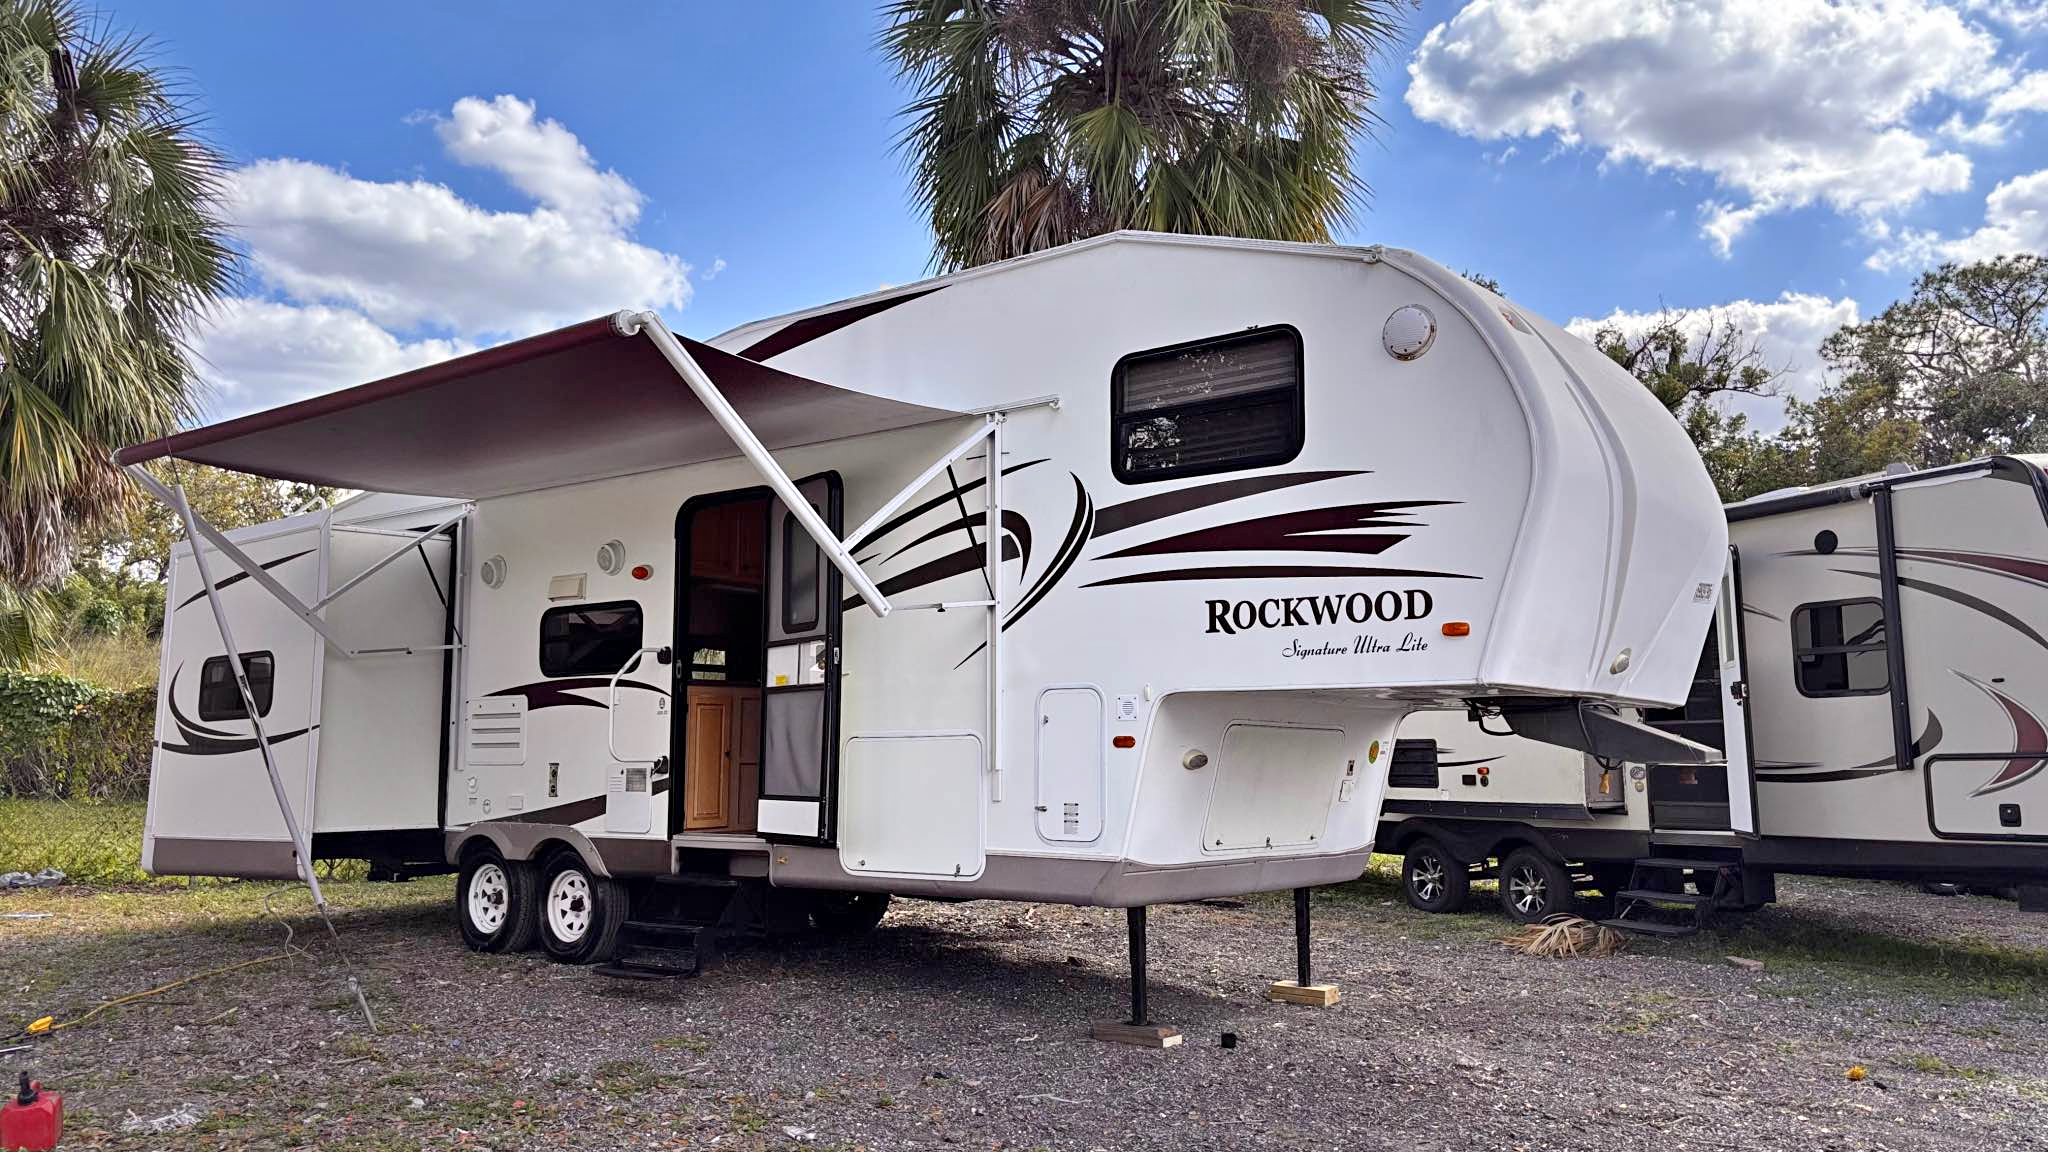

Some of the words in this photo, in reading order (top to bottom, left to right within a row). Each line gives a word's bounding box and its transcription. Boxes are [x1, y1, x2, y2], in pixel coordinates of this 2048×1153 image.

[1205, 589, 1434, 635] ROCKWOOD
[1281, 638, 1348, 660] Signature
[1354, 634, 1391, 655] Ultra
[1396, 631, 1429, 653] Lite
